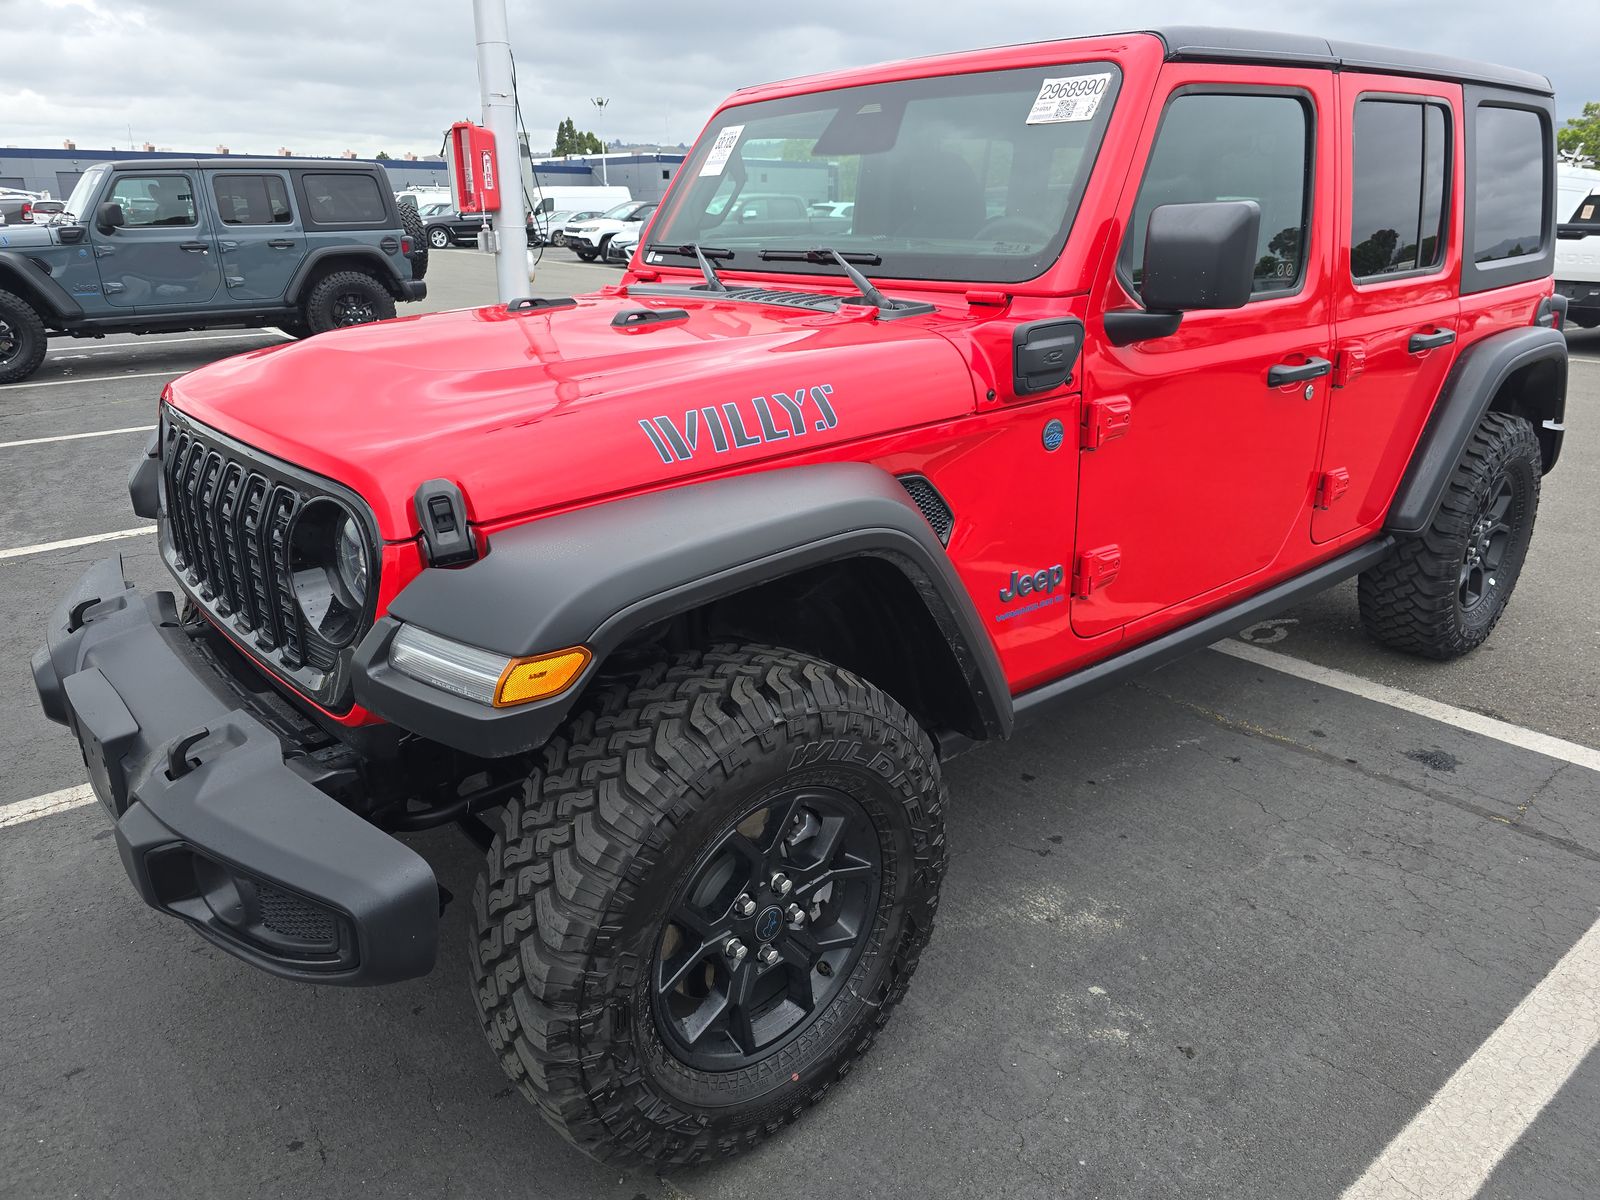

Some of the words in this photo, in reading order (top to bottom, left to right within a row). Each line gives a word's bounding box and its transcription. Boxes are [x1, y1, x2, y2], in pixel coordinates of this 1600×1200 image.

[1040, 78, 1106, 100] 2968990
[484, 159, 493, 188] FIRE
[638, 384, 838, 463] WILLYS
[999, 564, 1063, 602] Jeep
